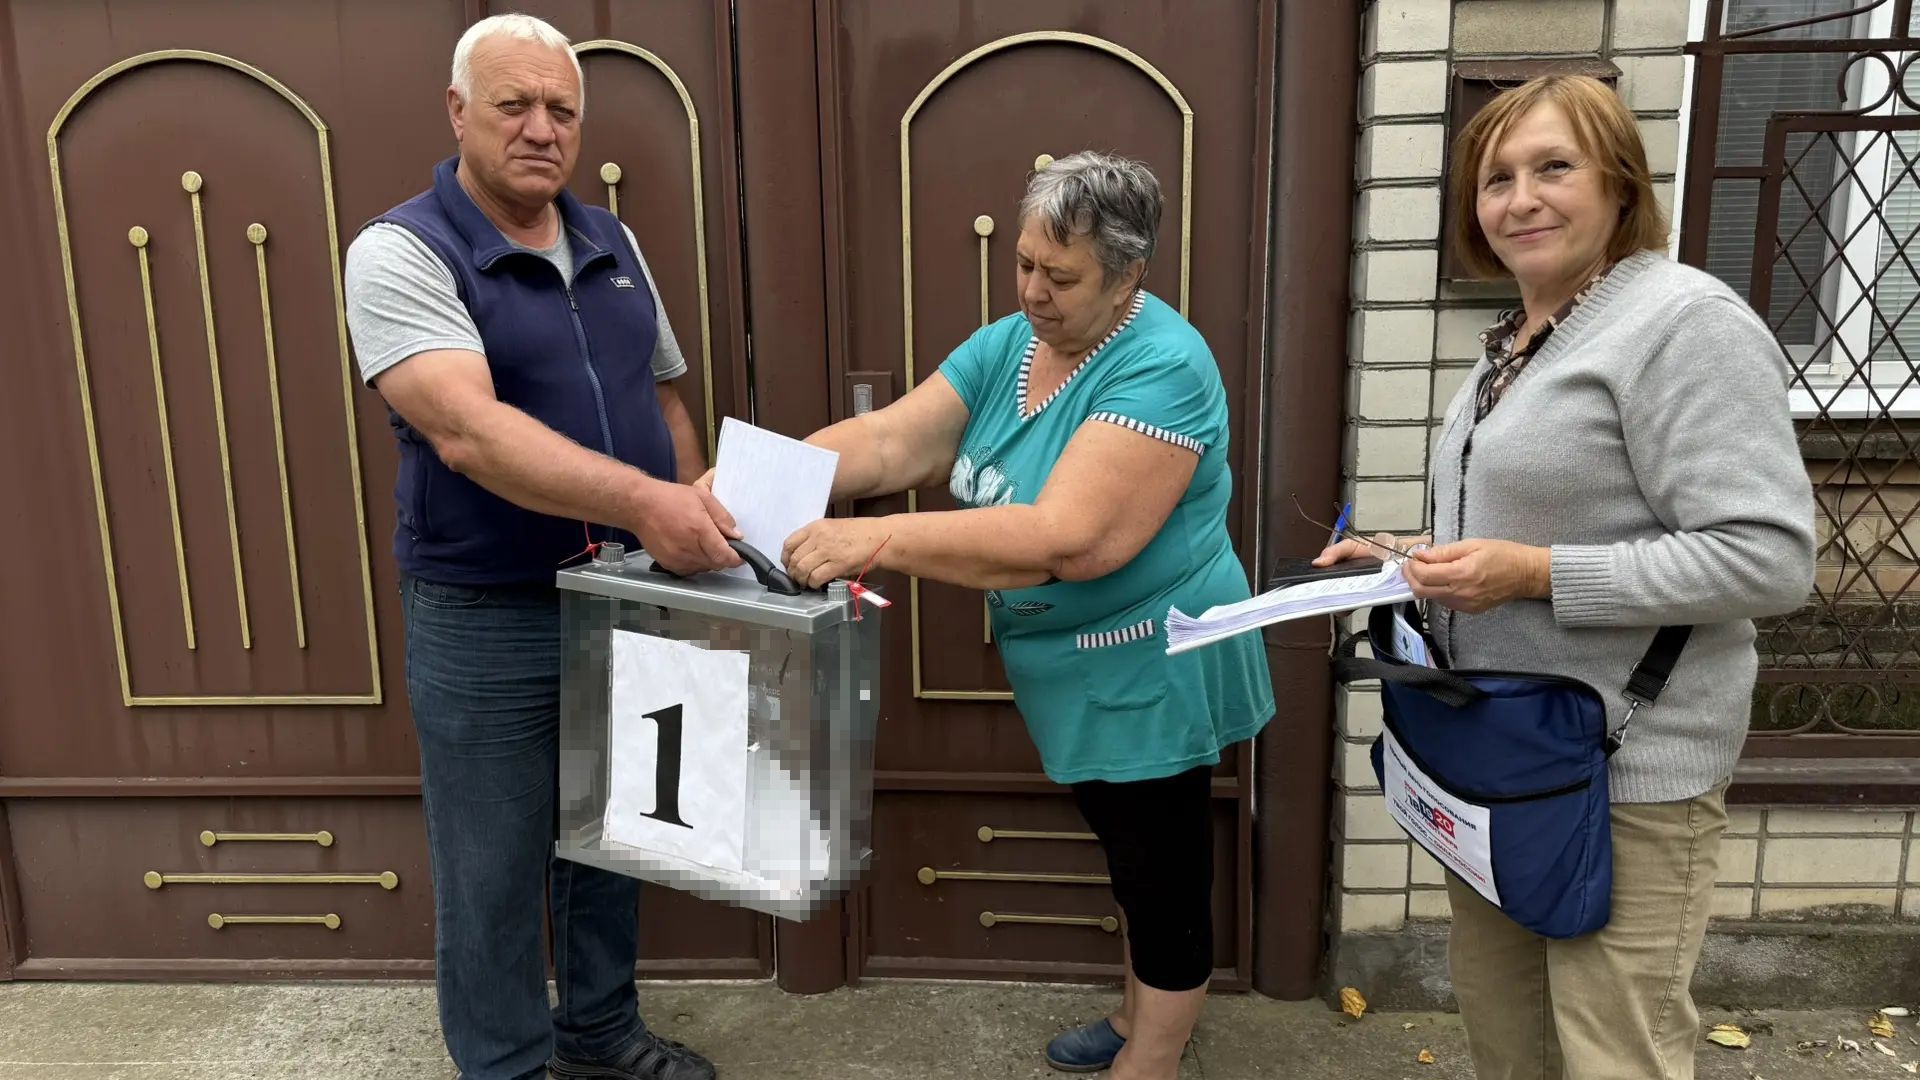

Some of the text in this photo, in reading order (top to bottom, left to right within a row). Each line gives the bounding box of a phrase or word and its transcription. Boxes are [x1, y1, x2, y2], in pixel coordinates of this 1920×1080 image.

[639, 703, 694, 829] 1
[1422, 785, 1477, 831] ГОЛОСОВАНИЯ
[1435, 811, 1452, 832] 20
